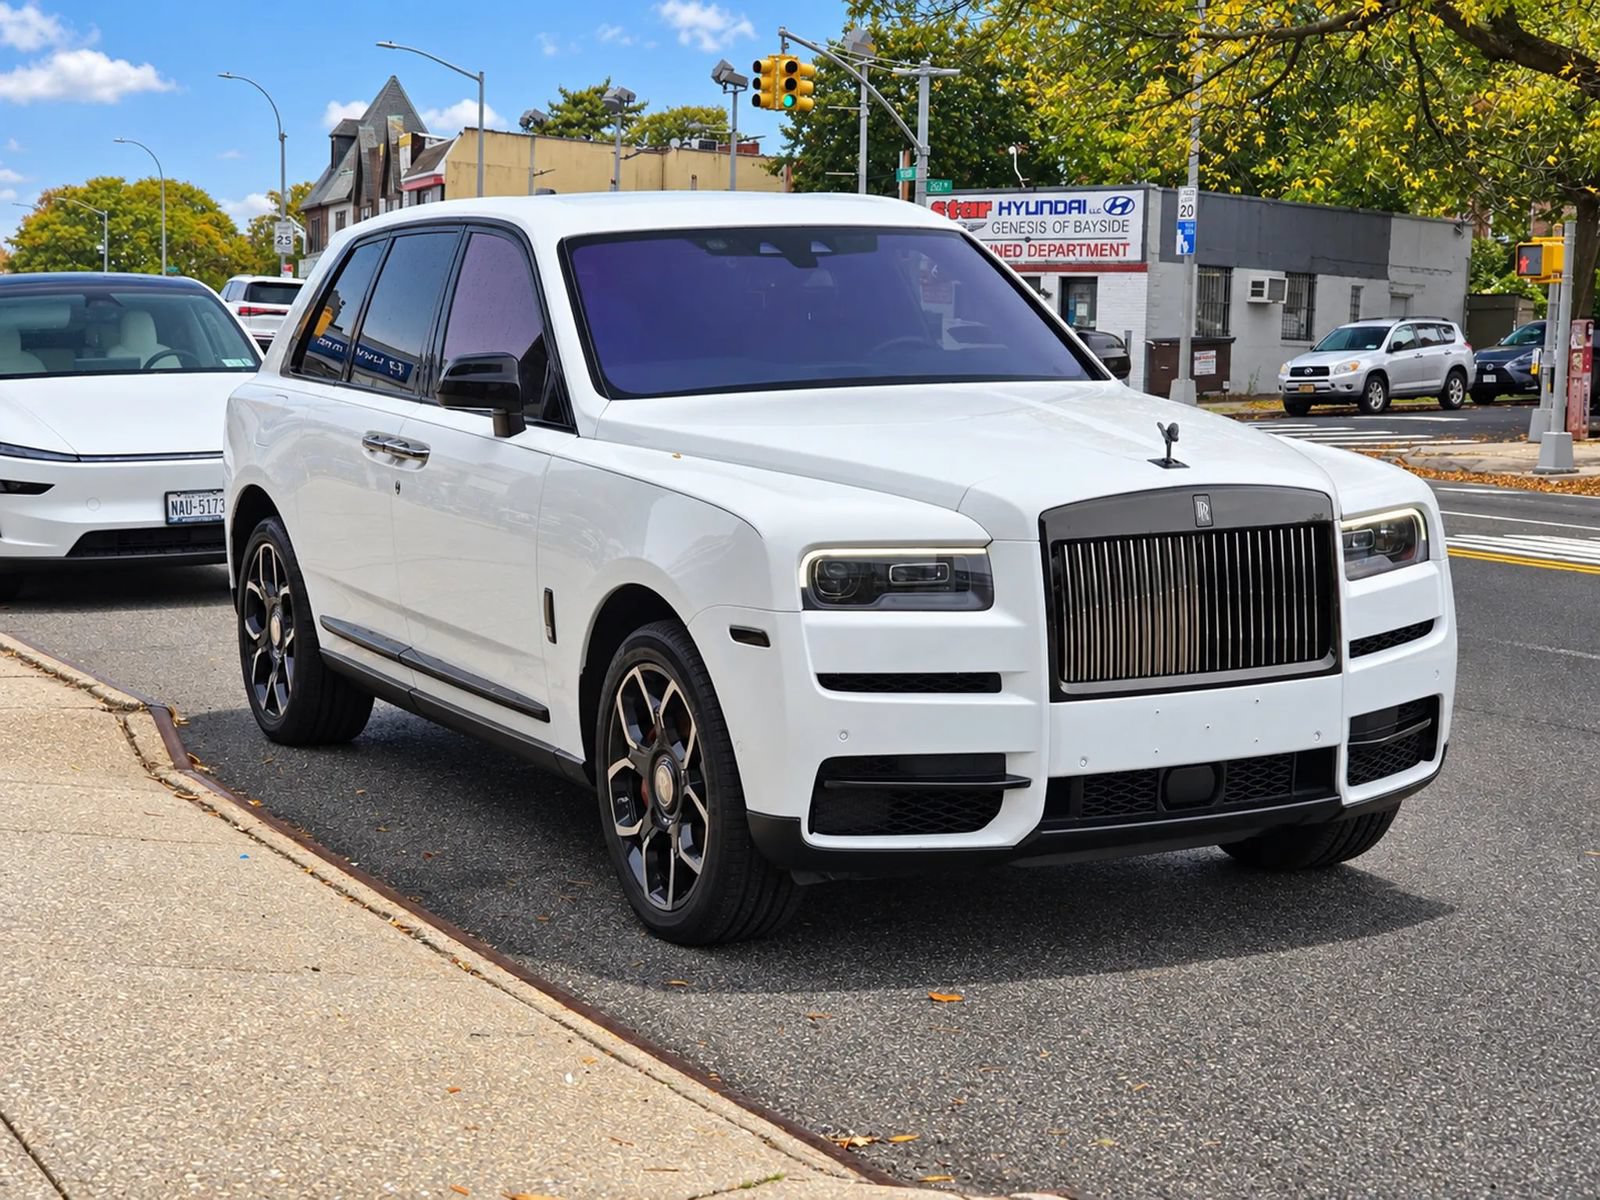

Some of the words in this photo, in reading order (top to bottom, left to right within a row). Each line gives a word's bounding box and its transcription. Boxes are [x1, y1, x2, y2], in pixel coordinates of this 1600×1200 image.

[931, 199, 992, 219] star
[998, 199, 1087, 216] HYUNDAI
[1180, 204, 1194, 217] 20
[991, 220, 1047, 234] GENESIS
[1052, 220, 1070, 234] OF
[1073, 219, 1130, 233] BAYSIDE
[276, 235, 291, 245] 25
[989, 244, 1023, 258] NED
[1027, 242, 1130, 257] DEPARTMENT
[171, 498, 225, 516] NAU-5173
